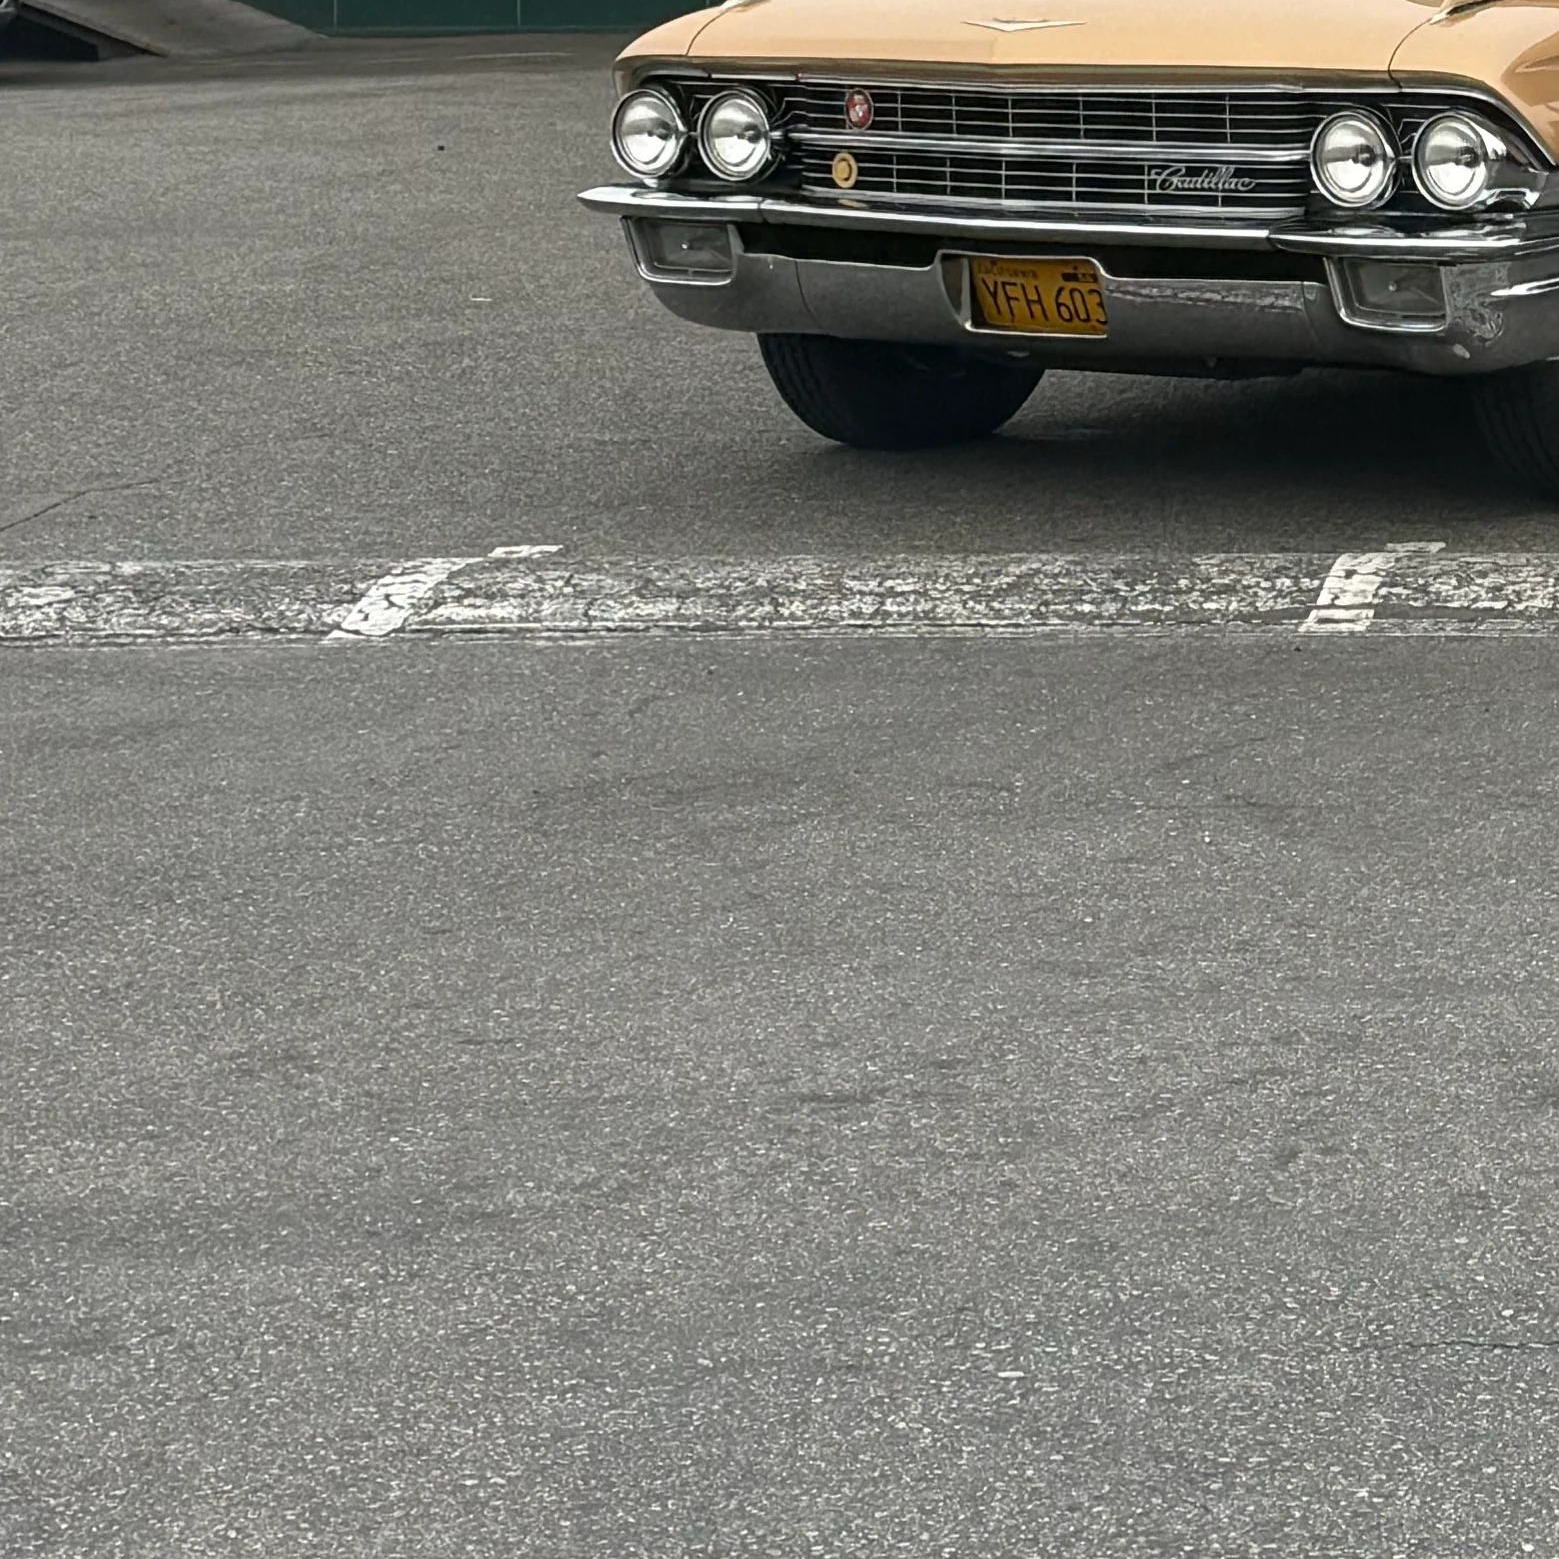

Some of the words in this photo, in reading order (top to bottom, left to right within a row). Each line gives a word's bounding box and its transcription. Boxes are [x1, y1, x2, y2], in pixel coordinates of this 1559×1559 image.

[1151, 165, 1256, 193] Cadillac
[982, 277, 1050, 321] YFH
[1054, 285, 1107, 325] 603
